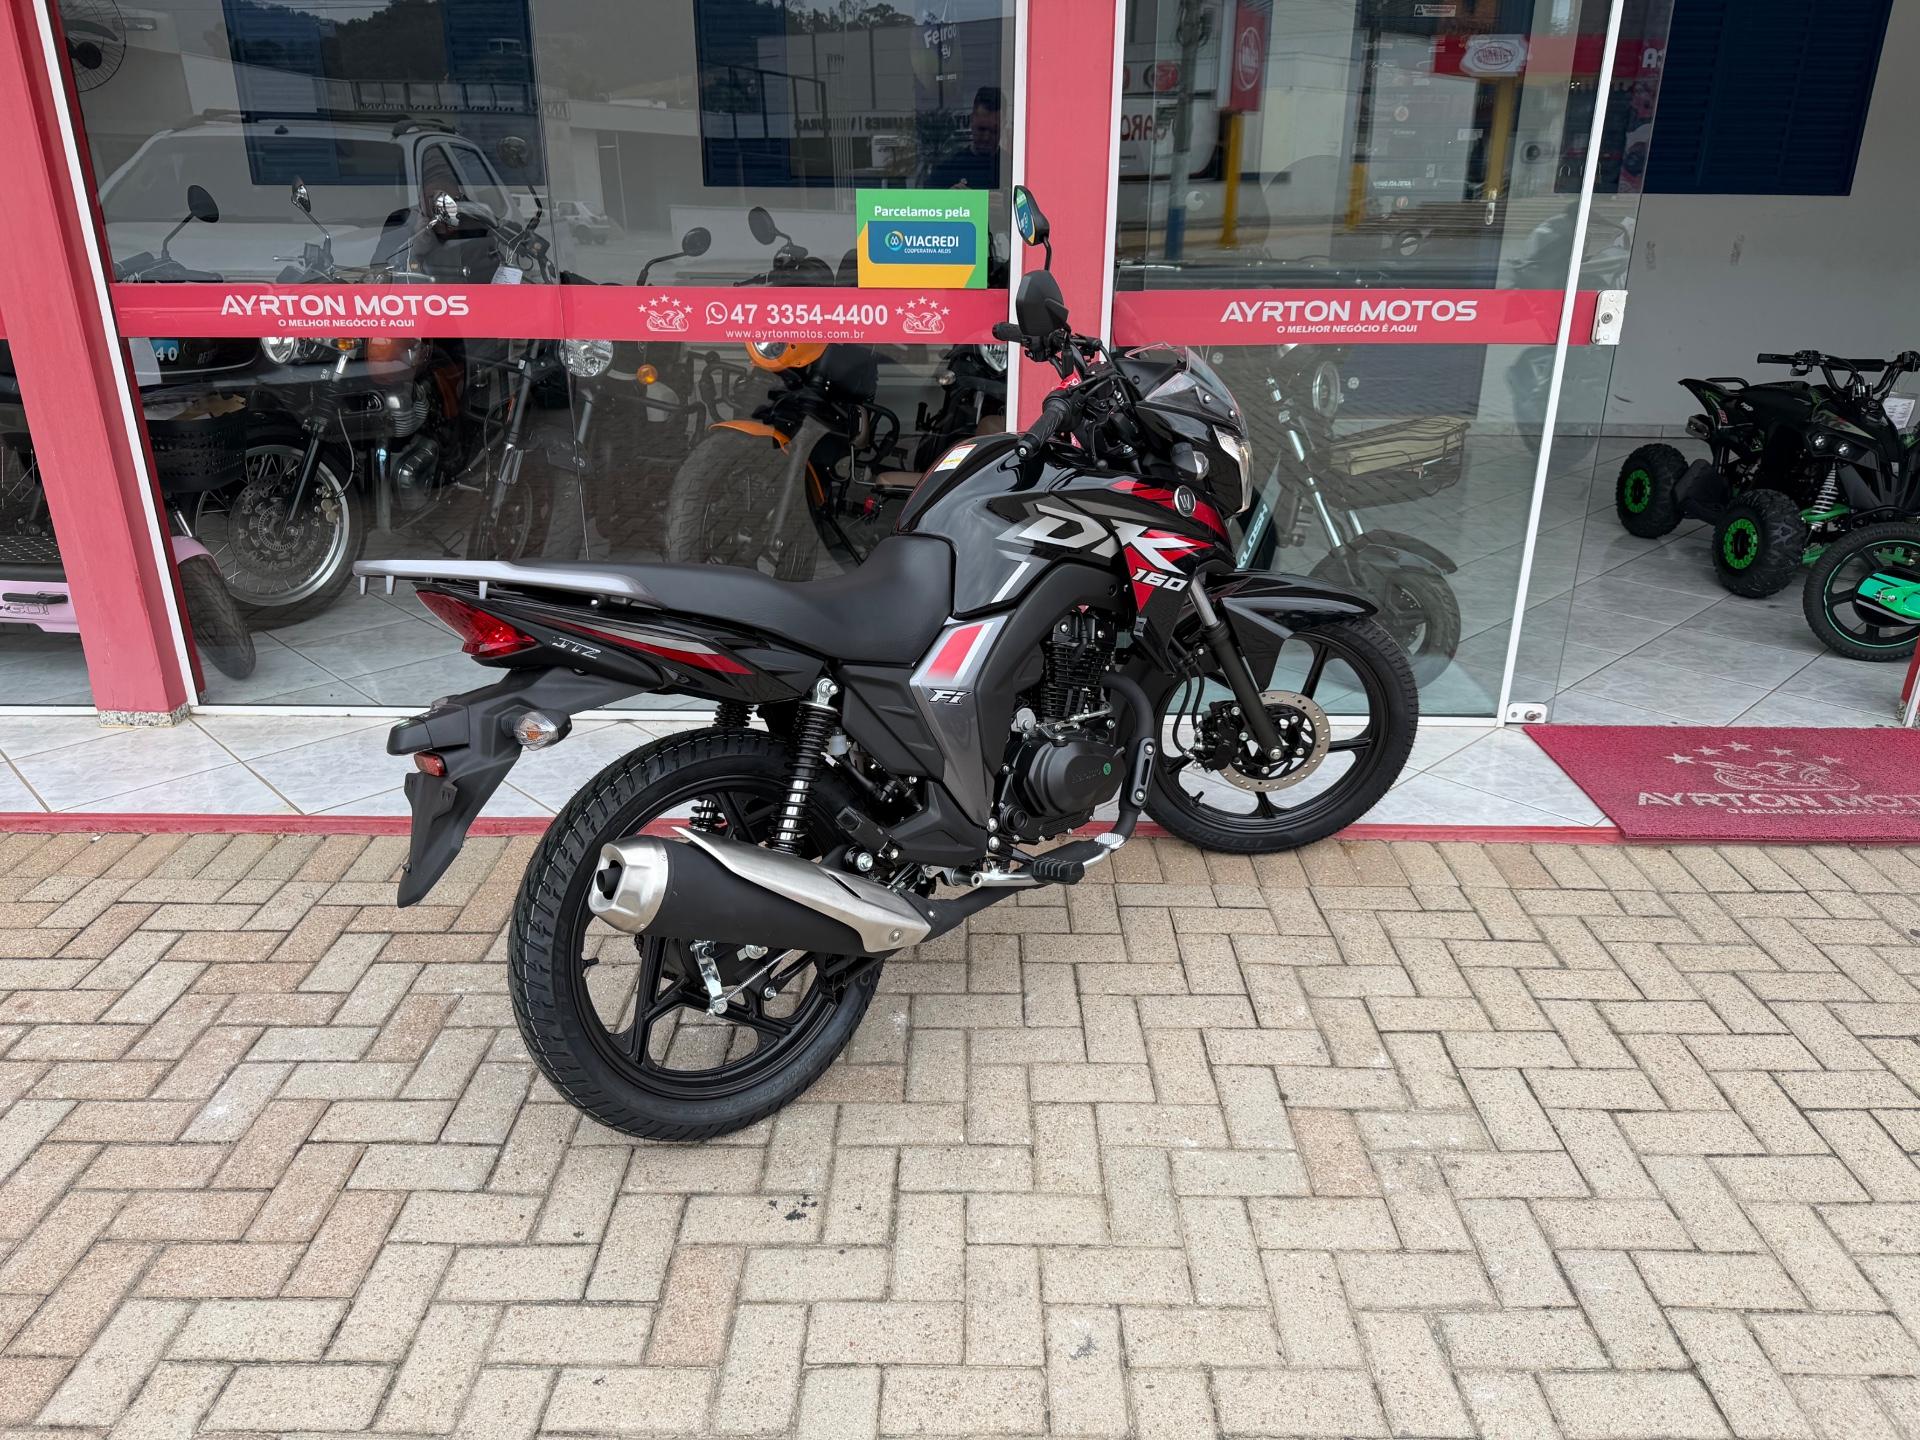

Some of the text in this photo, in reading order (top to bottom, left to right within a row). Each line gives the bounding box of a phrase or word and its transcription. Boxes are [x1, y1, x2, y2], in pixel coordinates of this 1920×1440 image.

[874, 205, 970, 220] Parcelamos pela
[904, 235, 959, 248] VIACREDI
[220, 294, 470, 316] AYRTON MOTOS
[1220, 299, 1479, 323] AYRTON MOTOS
[278, 317, 415, 328] O MELHOR NEGÓCIO É AQUI
[730, 303, 888, 325] 47 3354-4400
[725, 328, 865, 340] www.ayrtonmotos.com.br
[1276, 321, 1418, 334] O MELHOR NEGÓCIO É AQUI
[1131, 567, 1189, 592] 160
[928, 687, 972, 705] Fi
[1637, 791, 1822, 808] AYRTON
